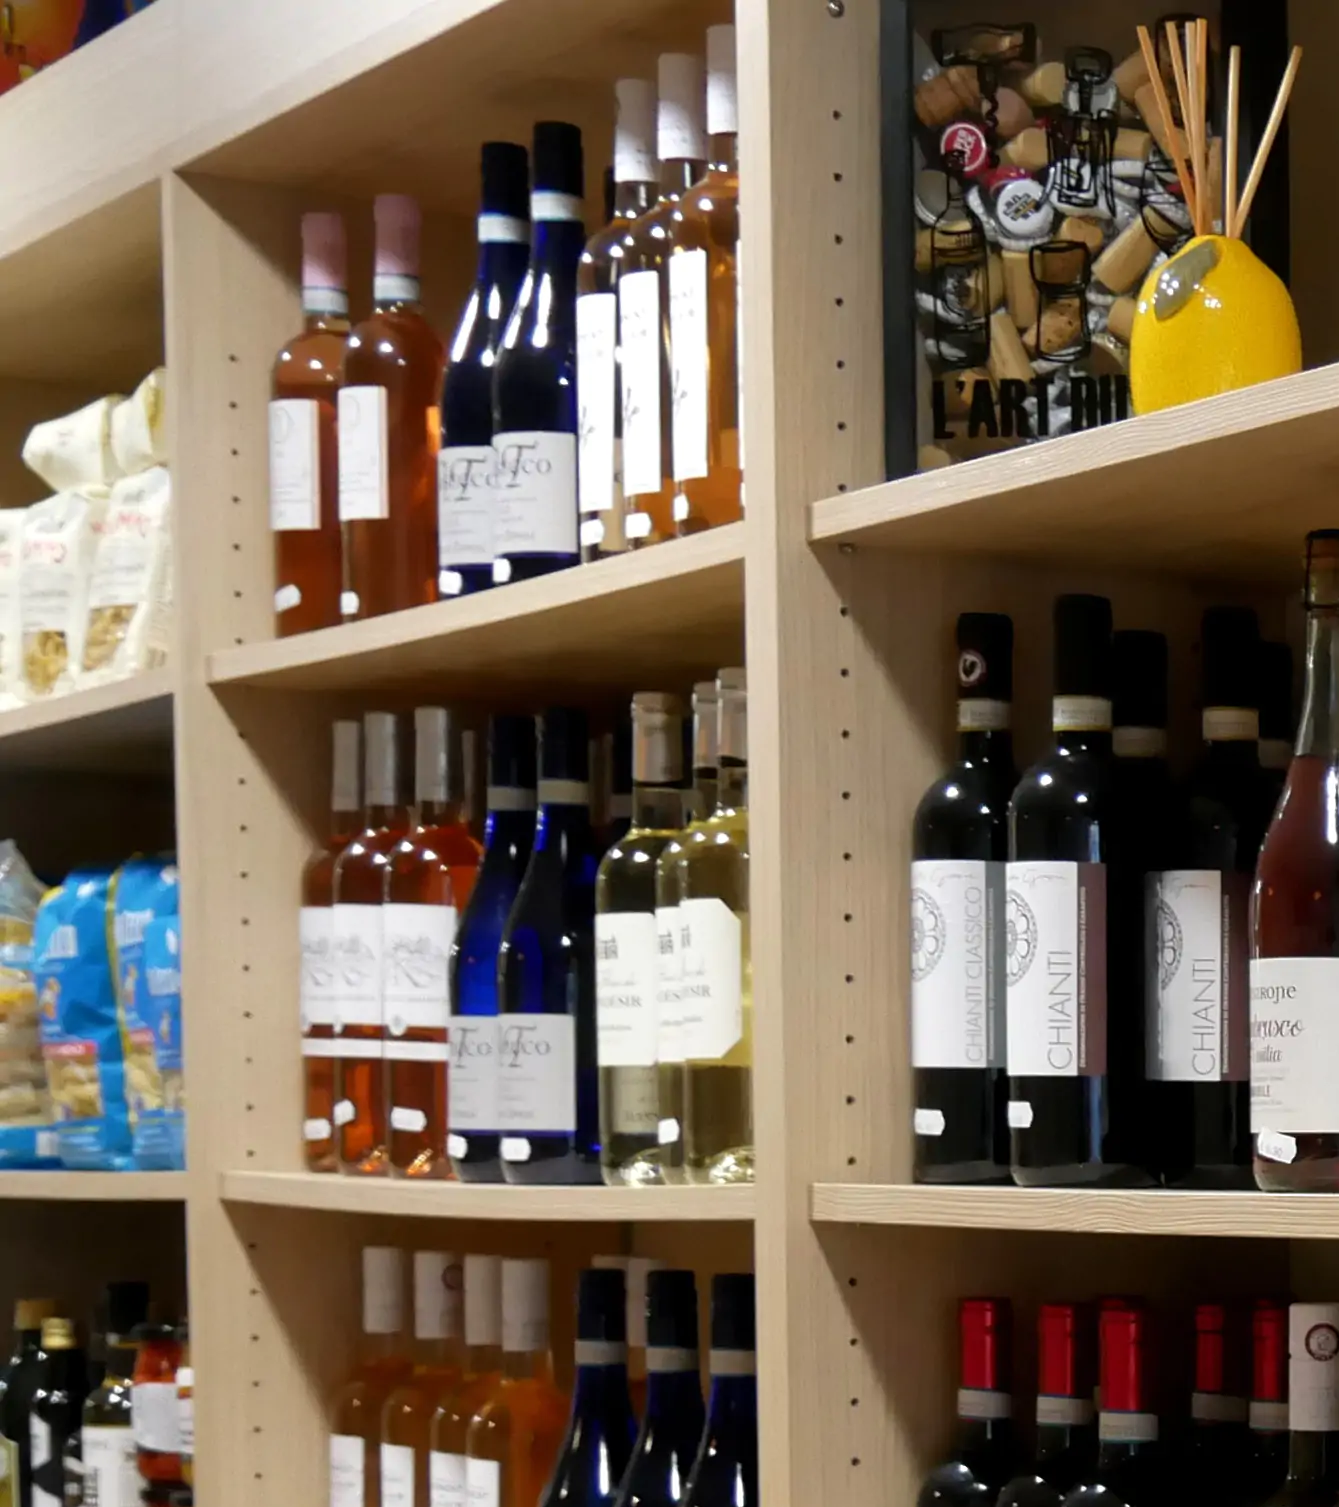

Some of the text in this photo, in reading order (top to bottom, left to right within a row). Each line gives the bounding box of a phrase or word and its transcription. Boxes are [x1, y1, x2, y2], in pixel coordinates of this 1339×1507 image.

[965, 986, 983, 1063] CHIANTI
[1047, 951, 1073, 1070] CHIANTI
[1191, 957, 1216, 1076] CHIANTI
